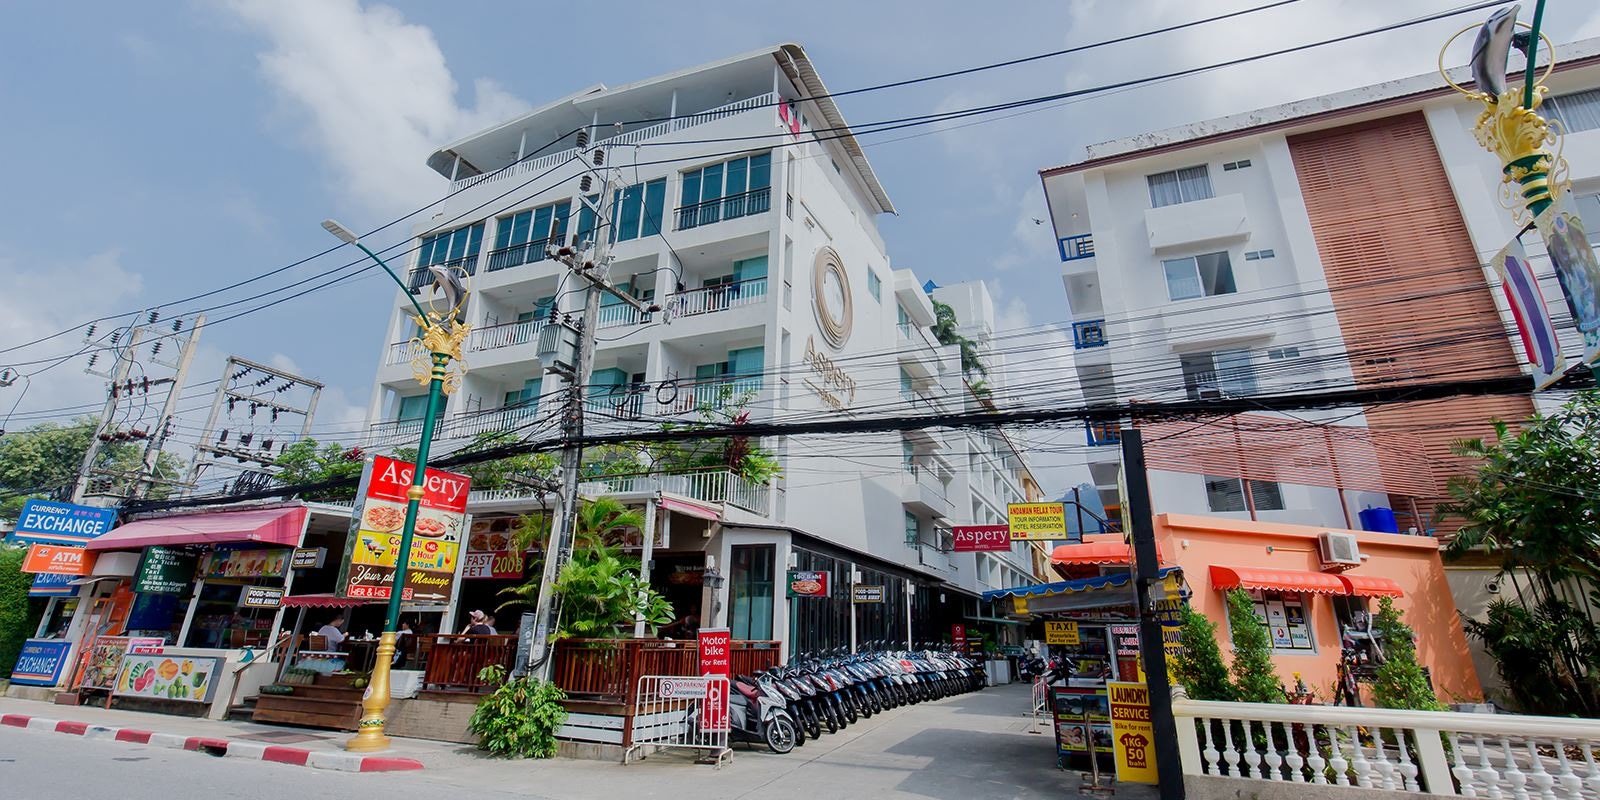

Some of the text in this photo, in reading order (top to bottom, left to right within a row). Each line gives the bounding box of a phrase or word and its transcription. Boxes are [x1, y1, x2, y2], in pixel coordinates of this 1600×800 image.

[31, 504, 70, 515] CURRENCY
[1033, 506, 1048, 514] RELAX
[1049, 506, 1063, 514] TOUR
[24, 513, 104, 534] EXCHANGE
[956, 529, 1007, 544] Aspery
[52, 551, 82, 562] ATM
[417, 551, 434, 560] Hour
[351, 565, 381, 585] Your
[411, 572, 449, 588] Massage
[351, 585, 386, 596] HER & HIS
[1050, 622, 1073, 630] TAXI
[702, 637, 727, 645] Motor
[705, 646, 724, 655] bike
[17, 656, 56, 673] EXCHANGE
[1111, 687, 1147, 704] LAUNDRY
[1113, 707, 1149, 719] SERVICE
[1128, 749, 1144, 760] 50
